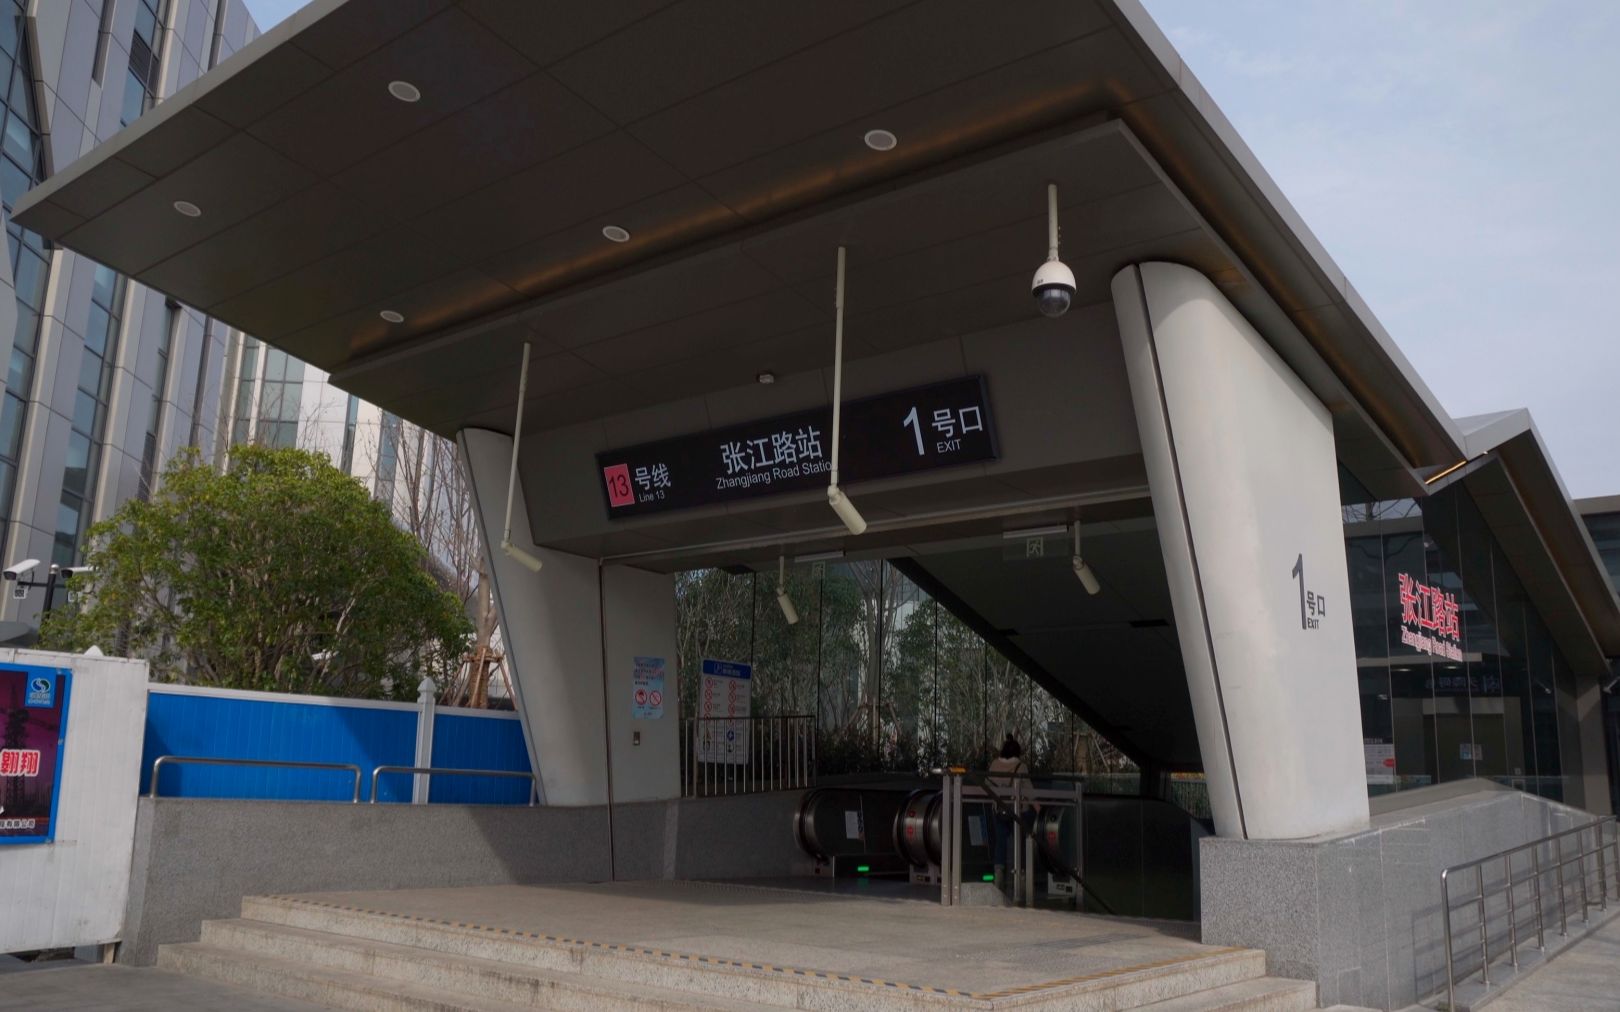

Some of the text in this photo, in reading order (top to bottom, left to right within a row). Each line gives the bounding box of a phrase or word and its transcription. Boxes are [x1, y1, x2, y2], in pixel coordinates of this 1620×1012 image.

[932, 405, 983, 438] 号口
[720, 425, 823, 475] 张江路站
[936, 438, 962, 454] EXIT
[609, 463, 671, 498] 13 号线
[715, 460, 834, 490] Zhangjiang Road Statio
[638, 490, 665, 503] Line 13
[1292, 553, 1326, 630] 1 号口
[1398, 572, 1460, 641] 张江路站
[1307, 618, 1320, 630] EXIT
[1401, 625, 1432, 656] Zhangjiang
